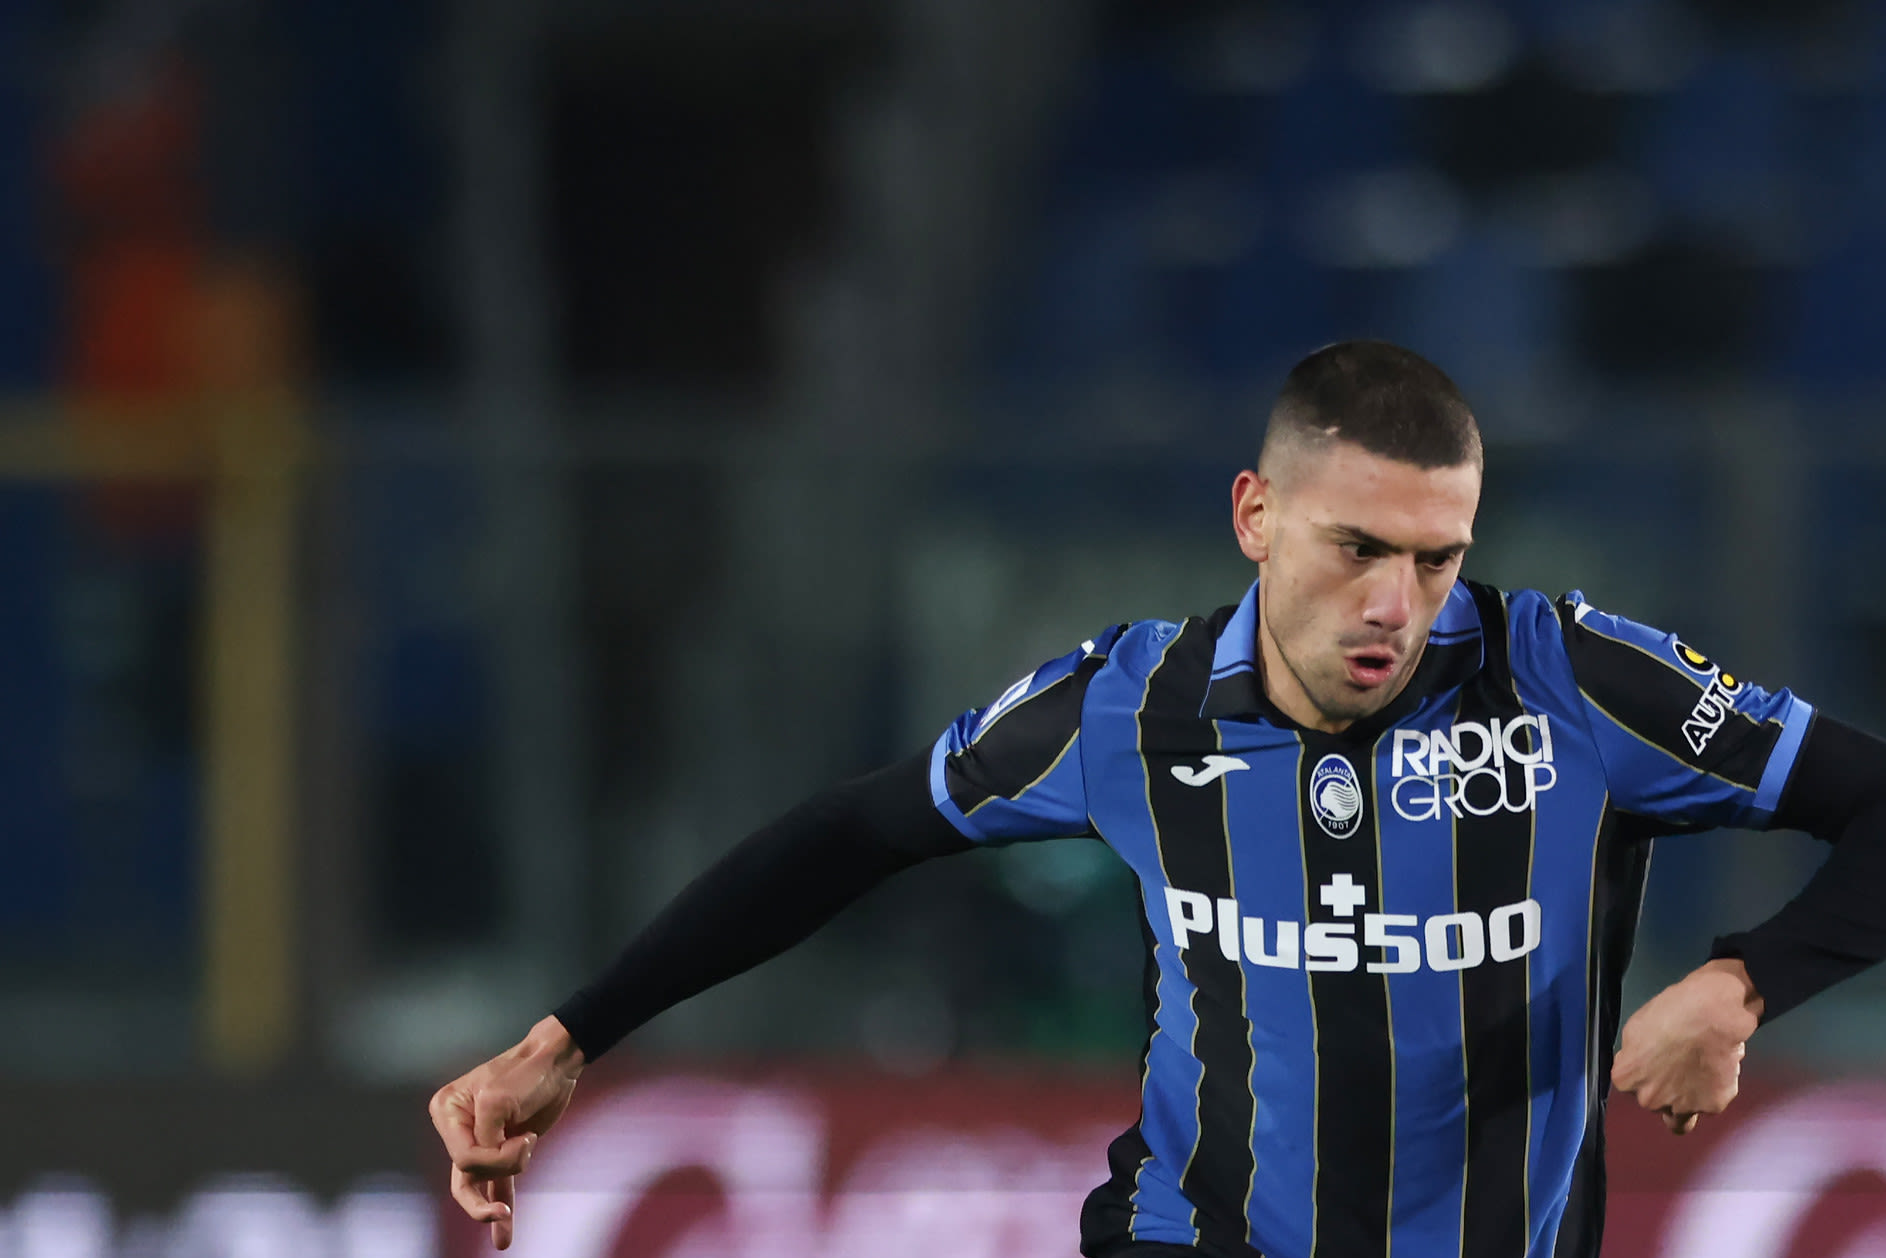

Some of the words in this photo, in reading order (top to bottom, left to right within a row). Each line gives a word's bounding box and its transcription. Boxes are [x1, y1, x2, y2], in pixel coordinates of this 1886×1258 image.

[1391, 714, 1554, 778] RADICI
[1391, 762, 1557, 822] GROUP
[1328, 820, 1350, 830] 1907
[1164, 887, 1542, 974] Plus500
